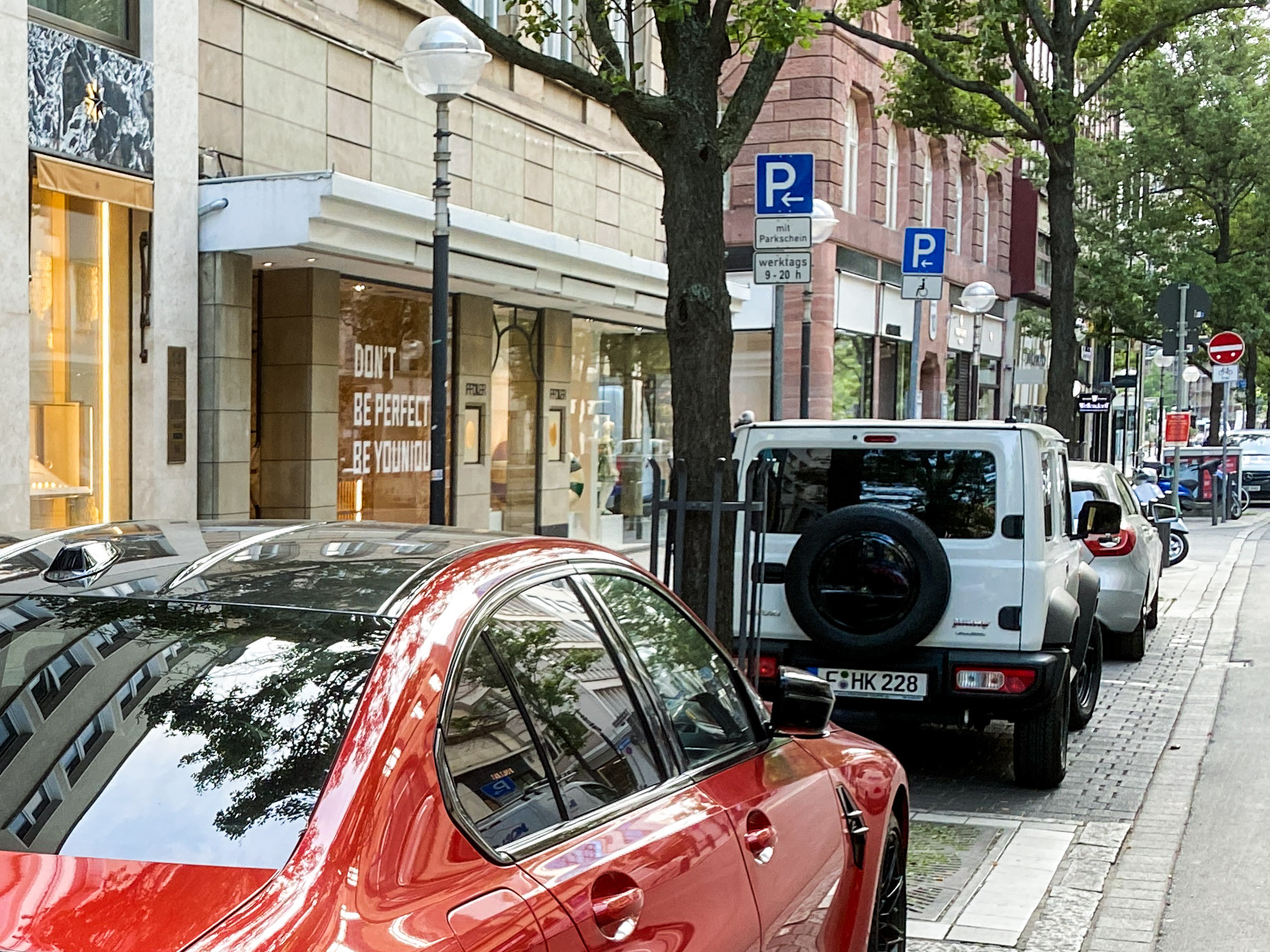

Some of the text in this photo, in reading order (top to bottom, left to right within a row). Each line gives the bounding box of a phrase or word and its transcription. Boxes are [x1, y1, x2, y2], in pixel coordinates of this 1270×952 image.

[766, 162, 796, 207] P
[759, 234, 808, 243] Parkschein
[912, 233, 936, 268] P
[759, 258, 808, 269] werktags
[354, 343, 397, 379] DON'T
[354, 392, 430, 427] BE PERFECT
[353, 441, 371, 475] BE
[851, 672, 877, 691] HK
[881, 673, 918, 692] 228
